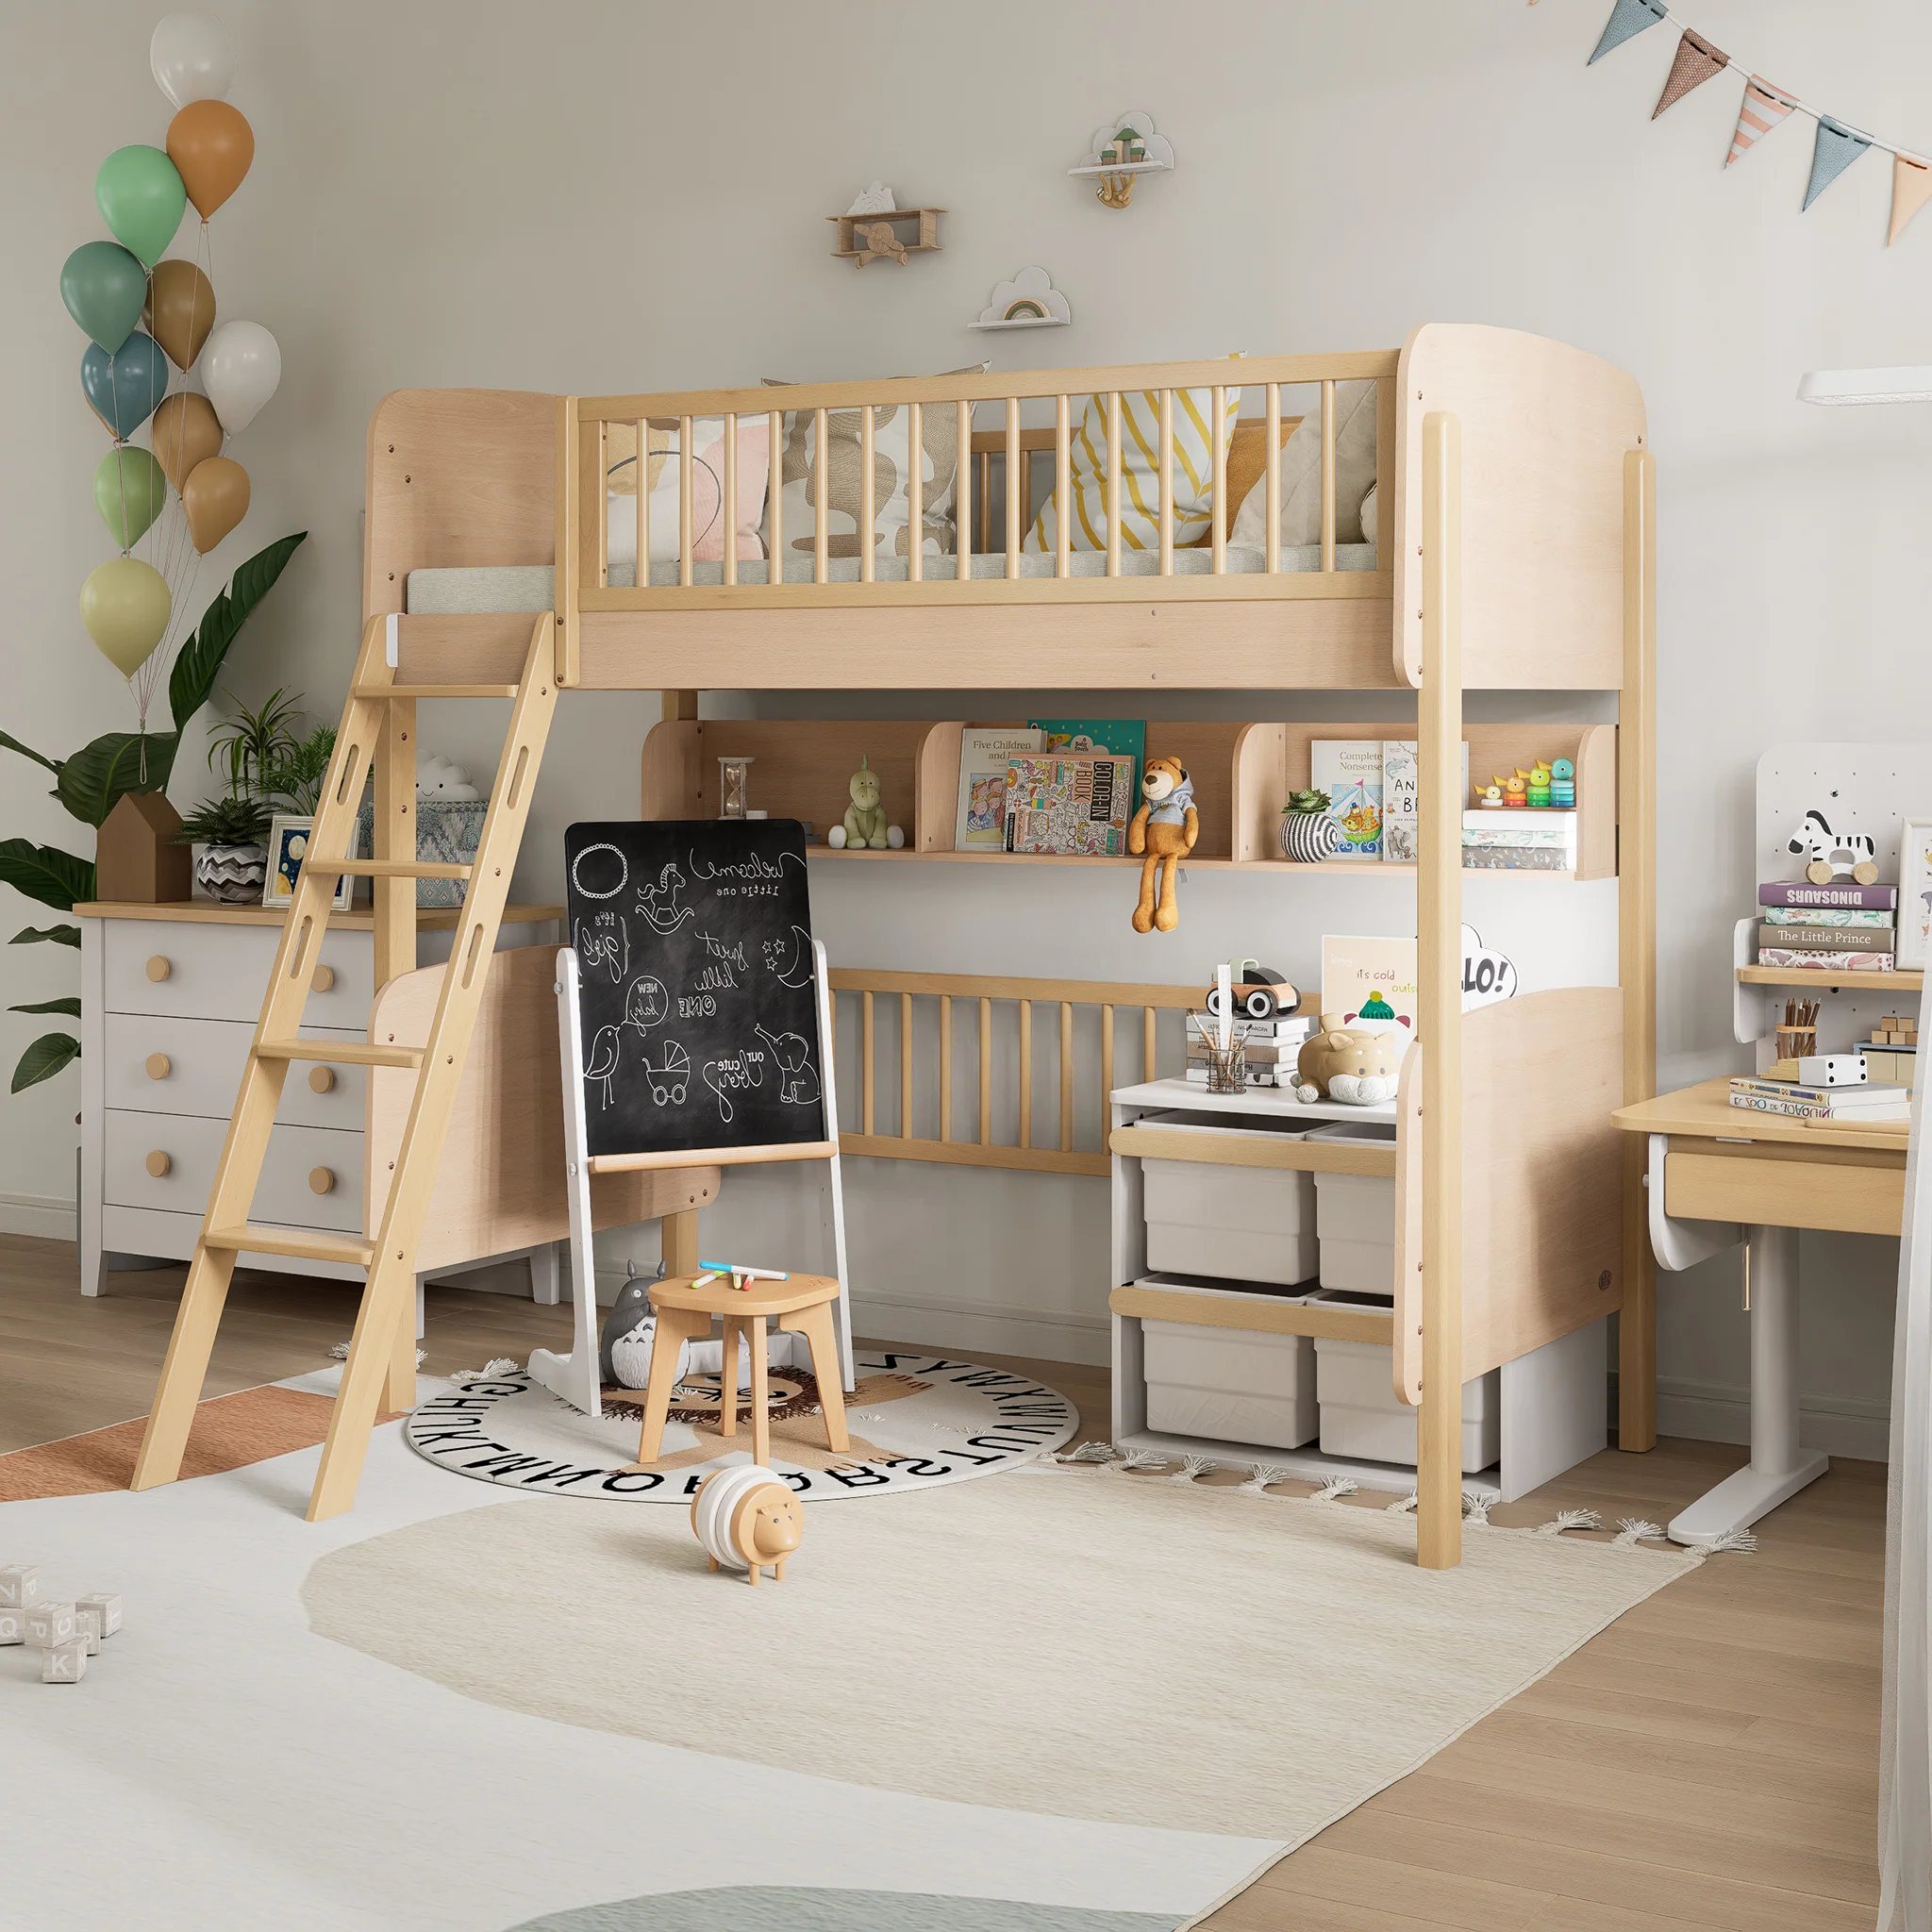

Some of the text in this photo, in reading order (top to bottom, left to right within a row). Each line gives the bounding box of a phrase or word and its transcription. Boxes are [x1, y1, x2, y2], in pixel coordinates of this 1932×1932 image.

[973, 740, 1031, 749] Five Children
[989, 751, 1006, 760] and
[1340, 752, 1383, 762] Complete
[1340, 762, 1383, 771] Nonsense
[1074, 770, 1092, 802] BOOK
[1403, 797, 1418, 813] B
[1787, 889, 1862, 906] DINOSAURS
[1777, 930, 1872, 945] The Little Prince
[1330, 953, 1353, 968] Baby
[1374, 970, 1395, 981] cold
[1460, 957, 1508, 994] LO!
[0, 1617, 18, 1638] Q
[51, 1655, 70, 1675] K
